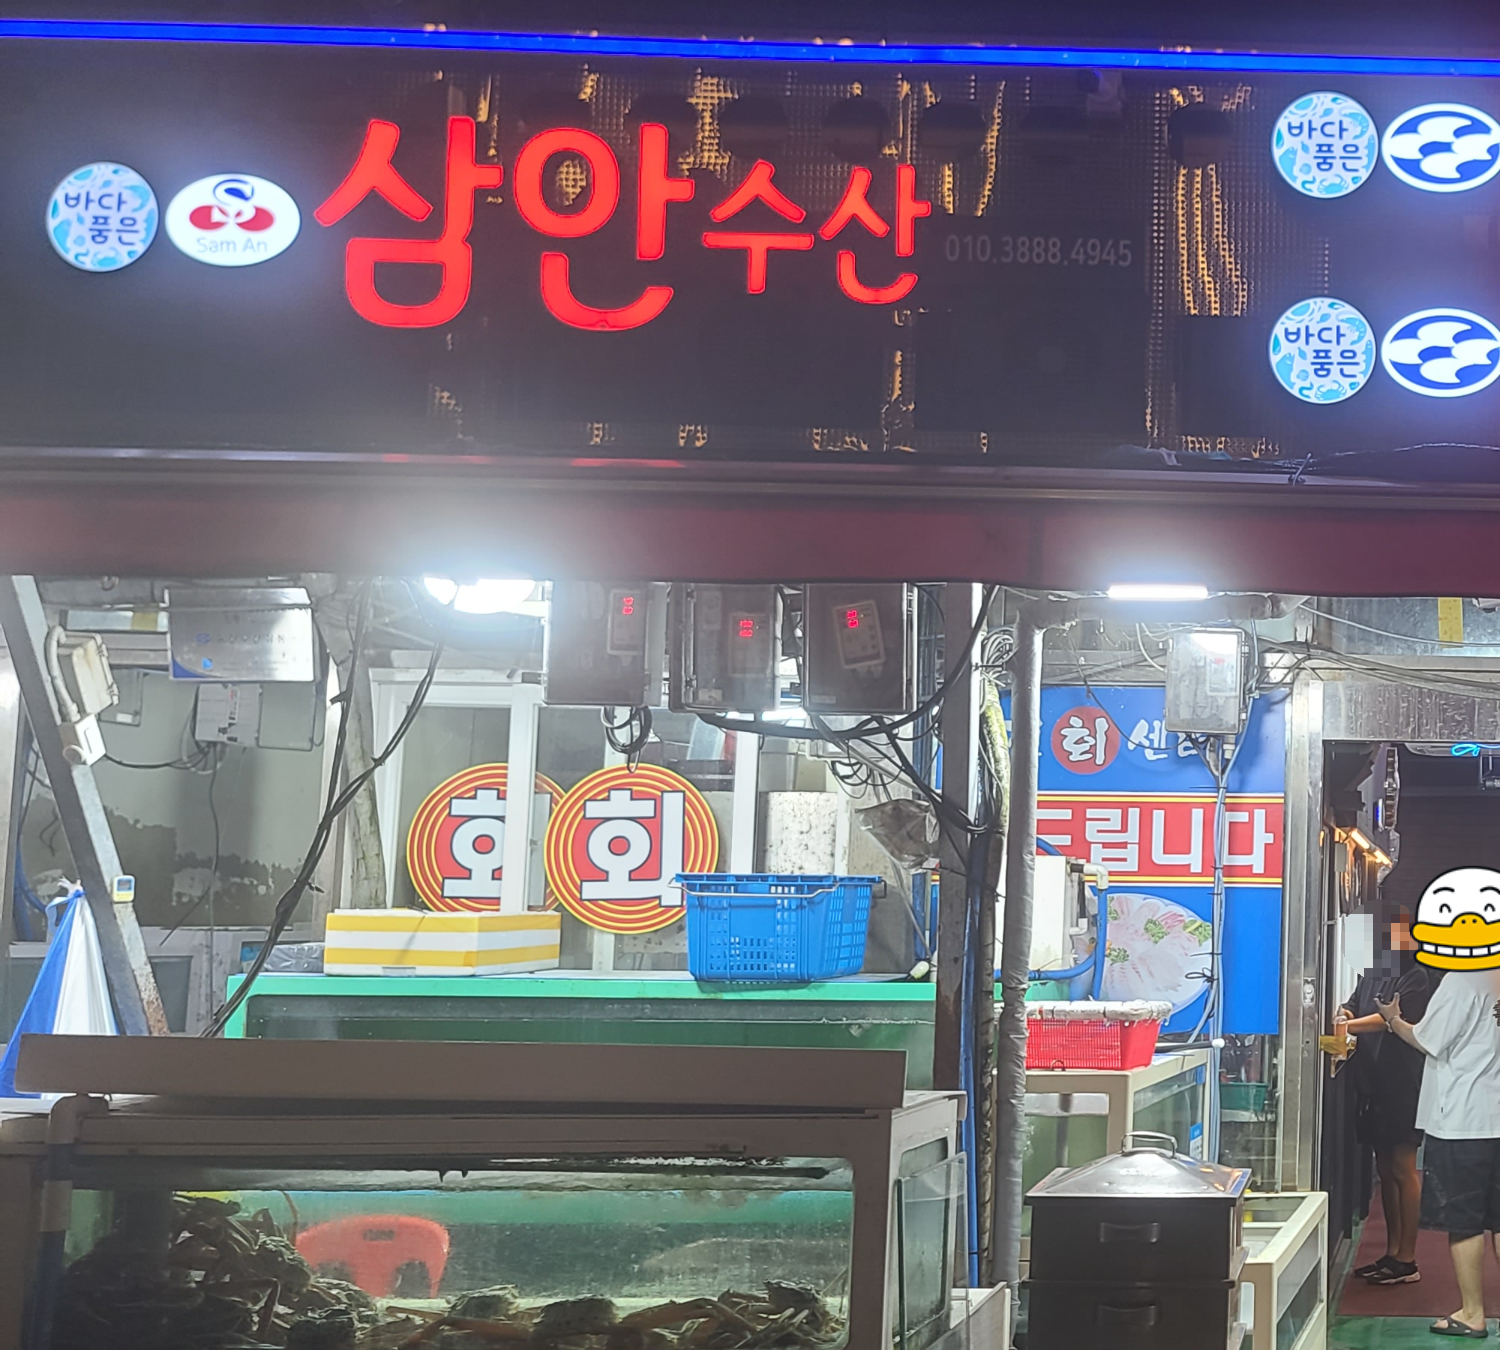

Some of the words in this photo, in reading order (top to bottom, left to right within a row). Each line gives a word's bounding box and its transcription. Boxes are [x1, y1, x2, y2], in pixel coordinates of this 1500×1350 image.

[1288, 118, 1350, 142] 바다
[1312, 142, 1363, 171] 품은
[64, 190, 128, 213] 바다
[88, 214, 140, 246] 품은
[197, 236, 238, 254] Sam
[243, 236, 269, 254] An
[944, 234, 1133, 268] 010.3888.4945
[1284, 324, 1347, 348] 바다
[1310, 350, 1361, 379] 품은
[1060, 716, 1109, 766] 회
[580, 788, 685, 908] 회
